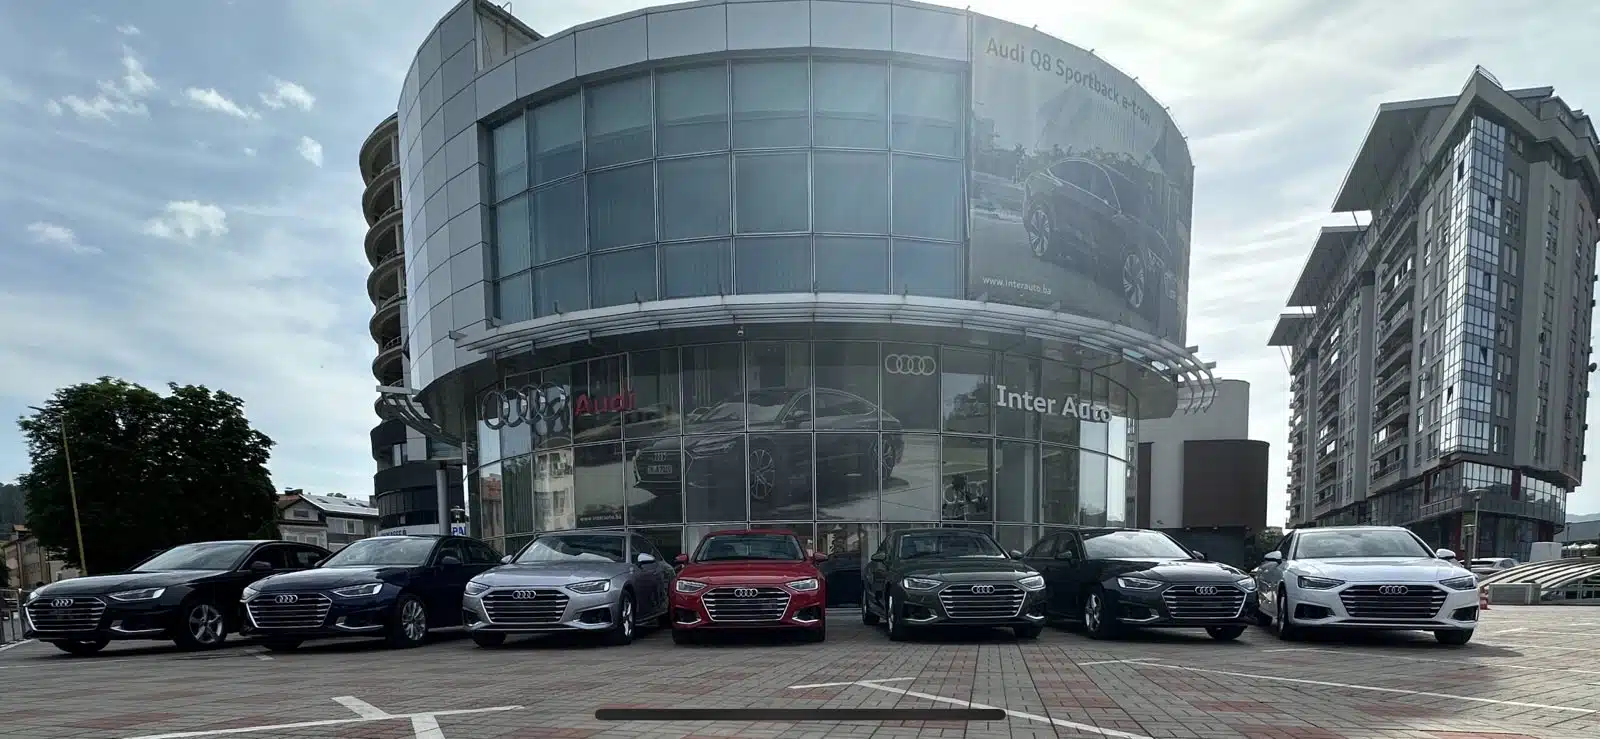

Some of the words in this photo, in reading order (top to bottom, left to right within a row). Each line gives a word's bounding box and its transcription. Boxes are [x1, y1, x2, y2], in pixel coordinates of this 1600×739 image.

[986, 37, 1025, 64] Audi
[1030, 49, 1052, 72] Q8
[1056, 59, 1119, 103] Sportback
[1122, 95, 1150, 125] e-tron
[982, 276, 1052, 295] www.interauto.ba
[574, 386, 636, 416] Audi
[996, 385, 1056, 415] Inter
[1062, 395, 1113, 423] Auto
